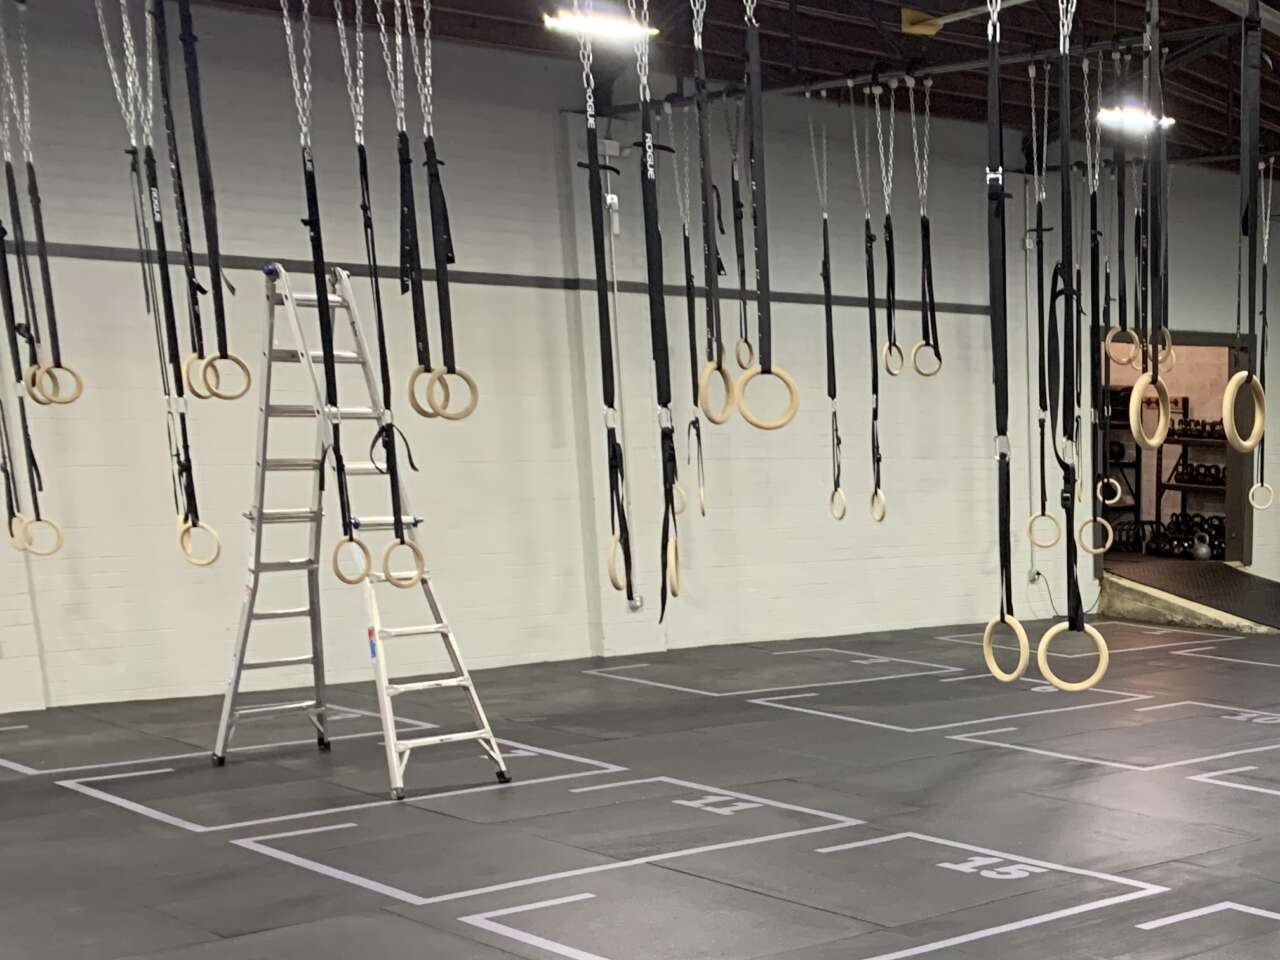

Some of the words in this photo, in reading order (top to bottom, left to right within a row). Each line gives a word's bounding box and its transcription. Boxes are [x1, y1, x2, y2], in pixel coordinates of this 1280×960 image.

[645, 132, 656, 180] ROGUE
[672, 795, 766, 815] 11
[936, 855, 1051, 880] 15
